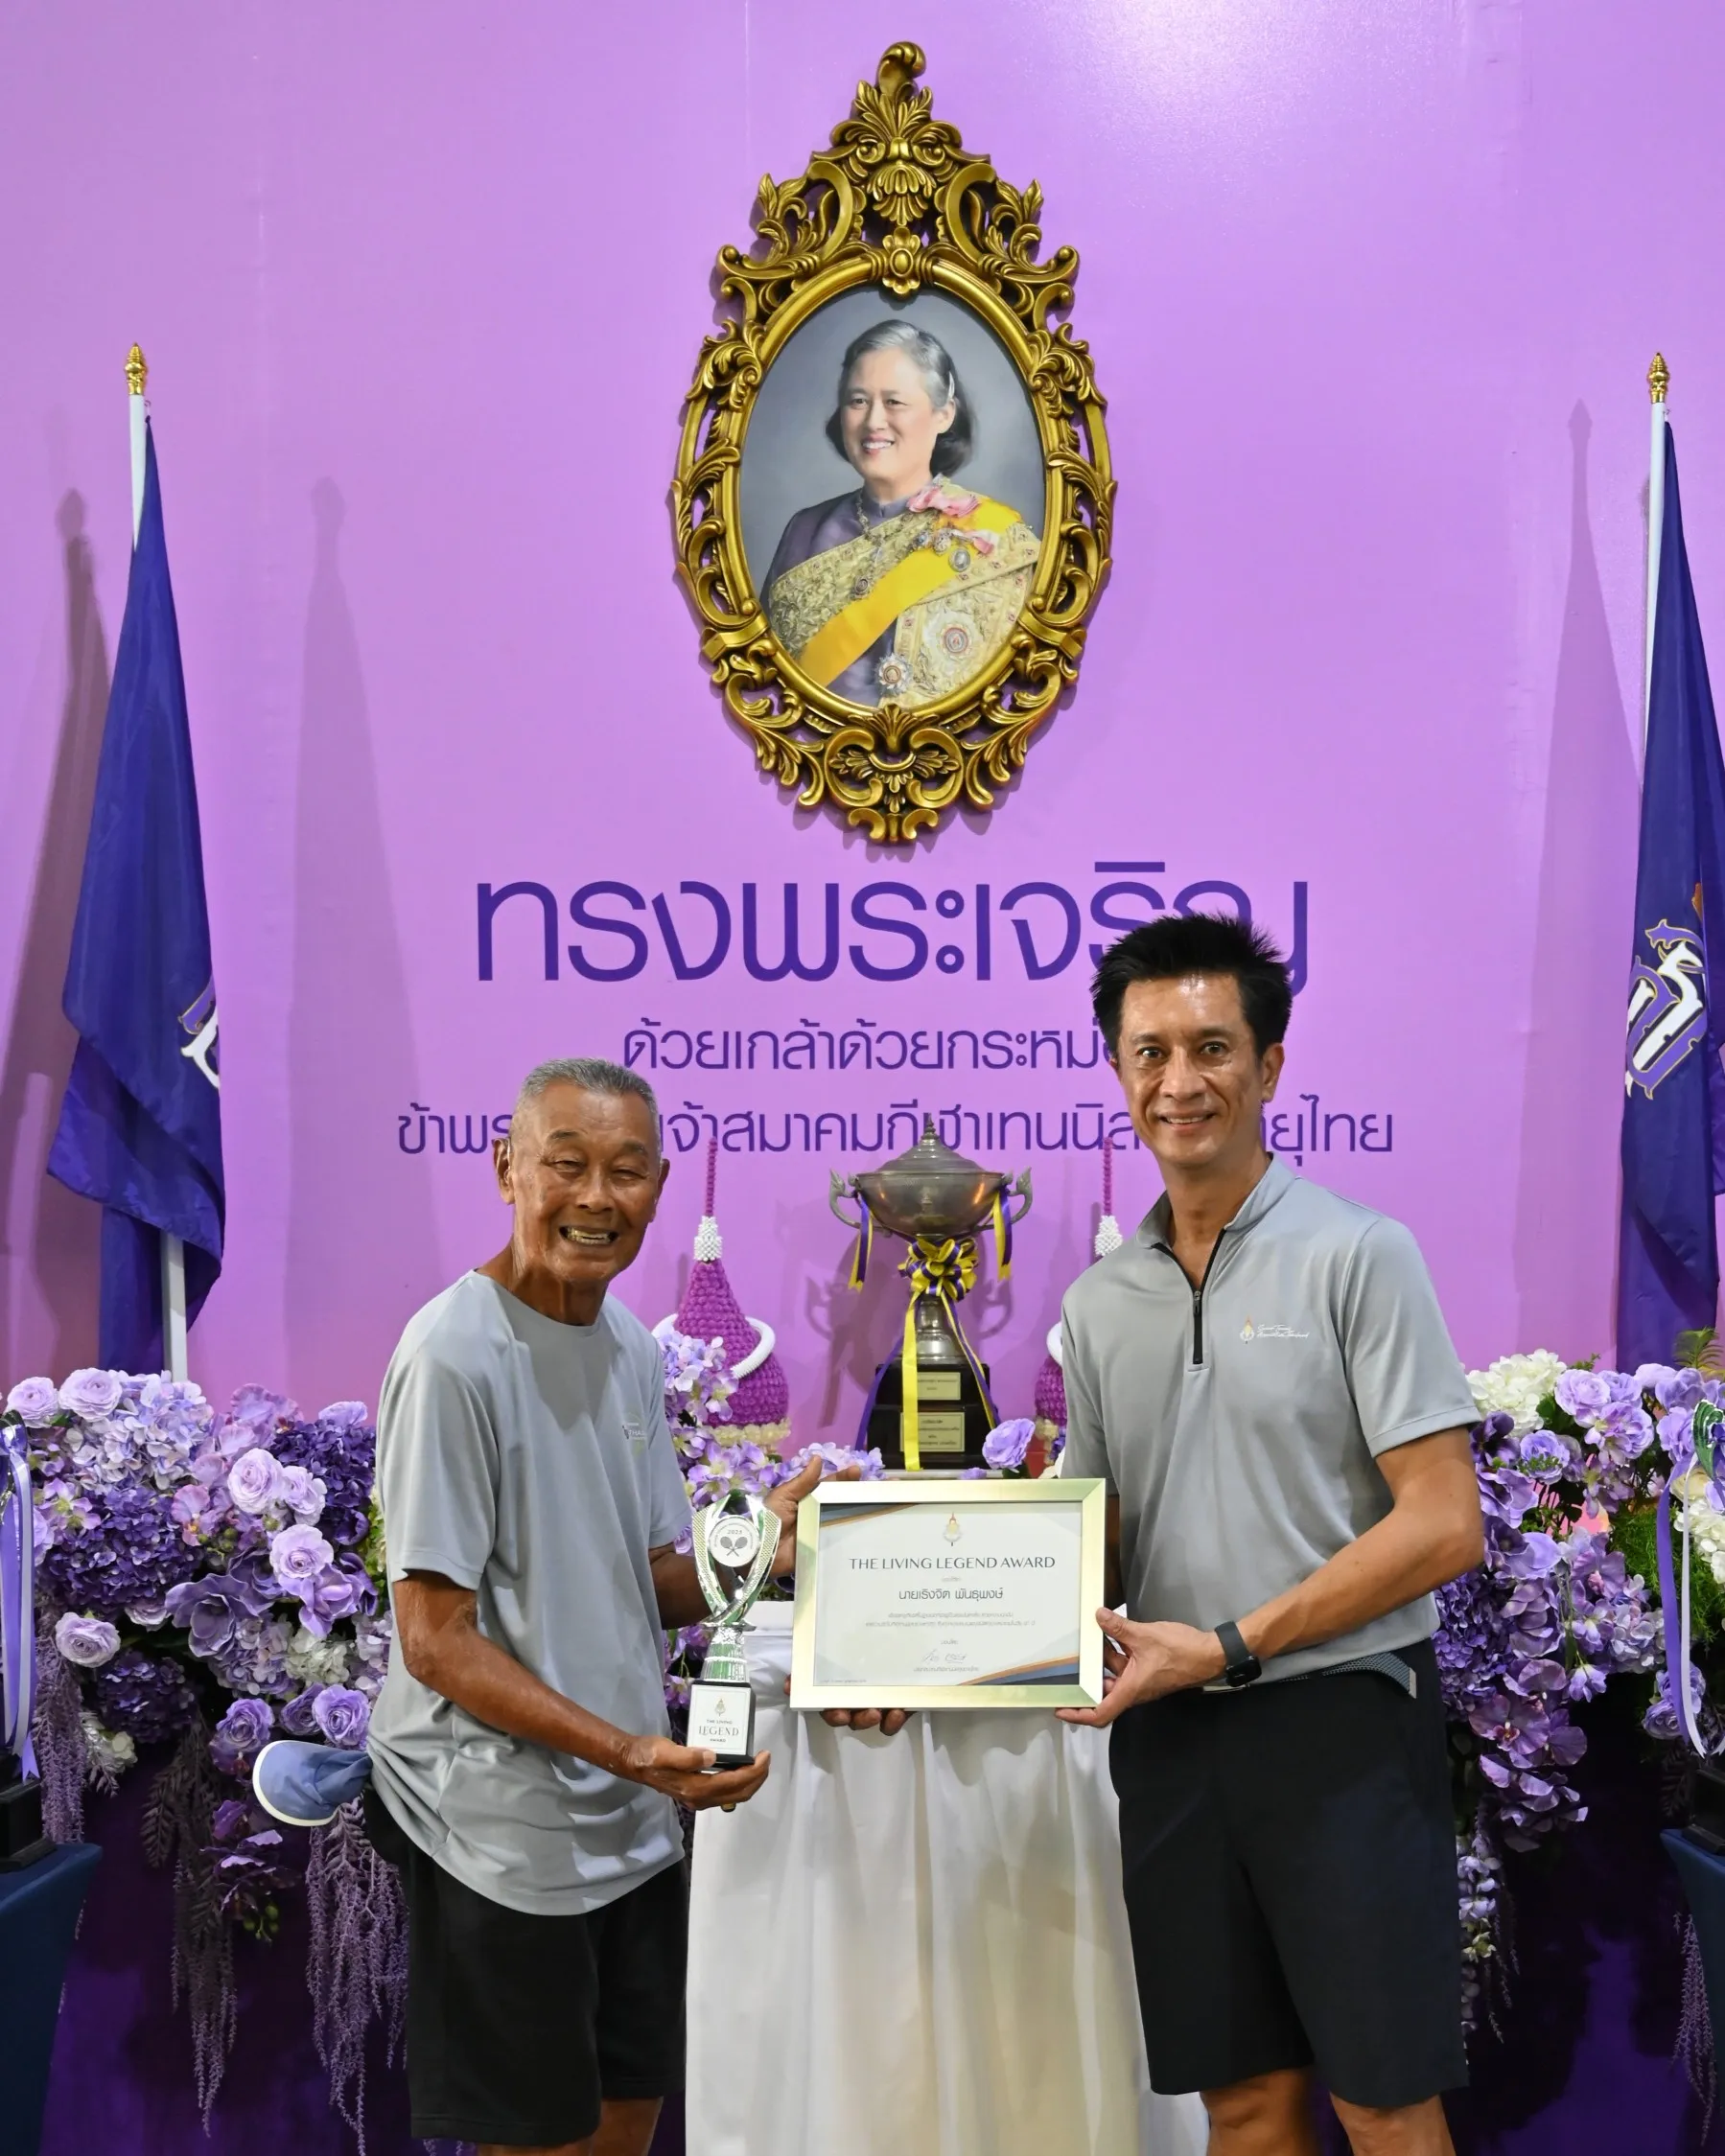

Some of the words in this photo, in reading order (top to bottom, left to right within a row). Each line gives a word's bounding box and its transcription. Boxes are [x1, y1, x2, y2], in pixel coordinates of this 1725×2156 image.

[849, 1558, 879, 1570] THE
[882, 1558, 932, 1569] LIVING
[936, 1557, 998, 1569] LEGEND
[1000, 1556, 1056, 1568] AWARD
[698, 1725, 740, 1736] LEGEND
